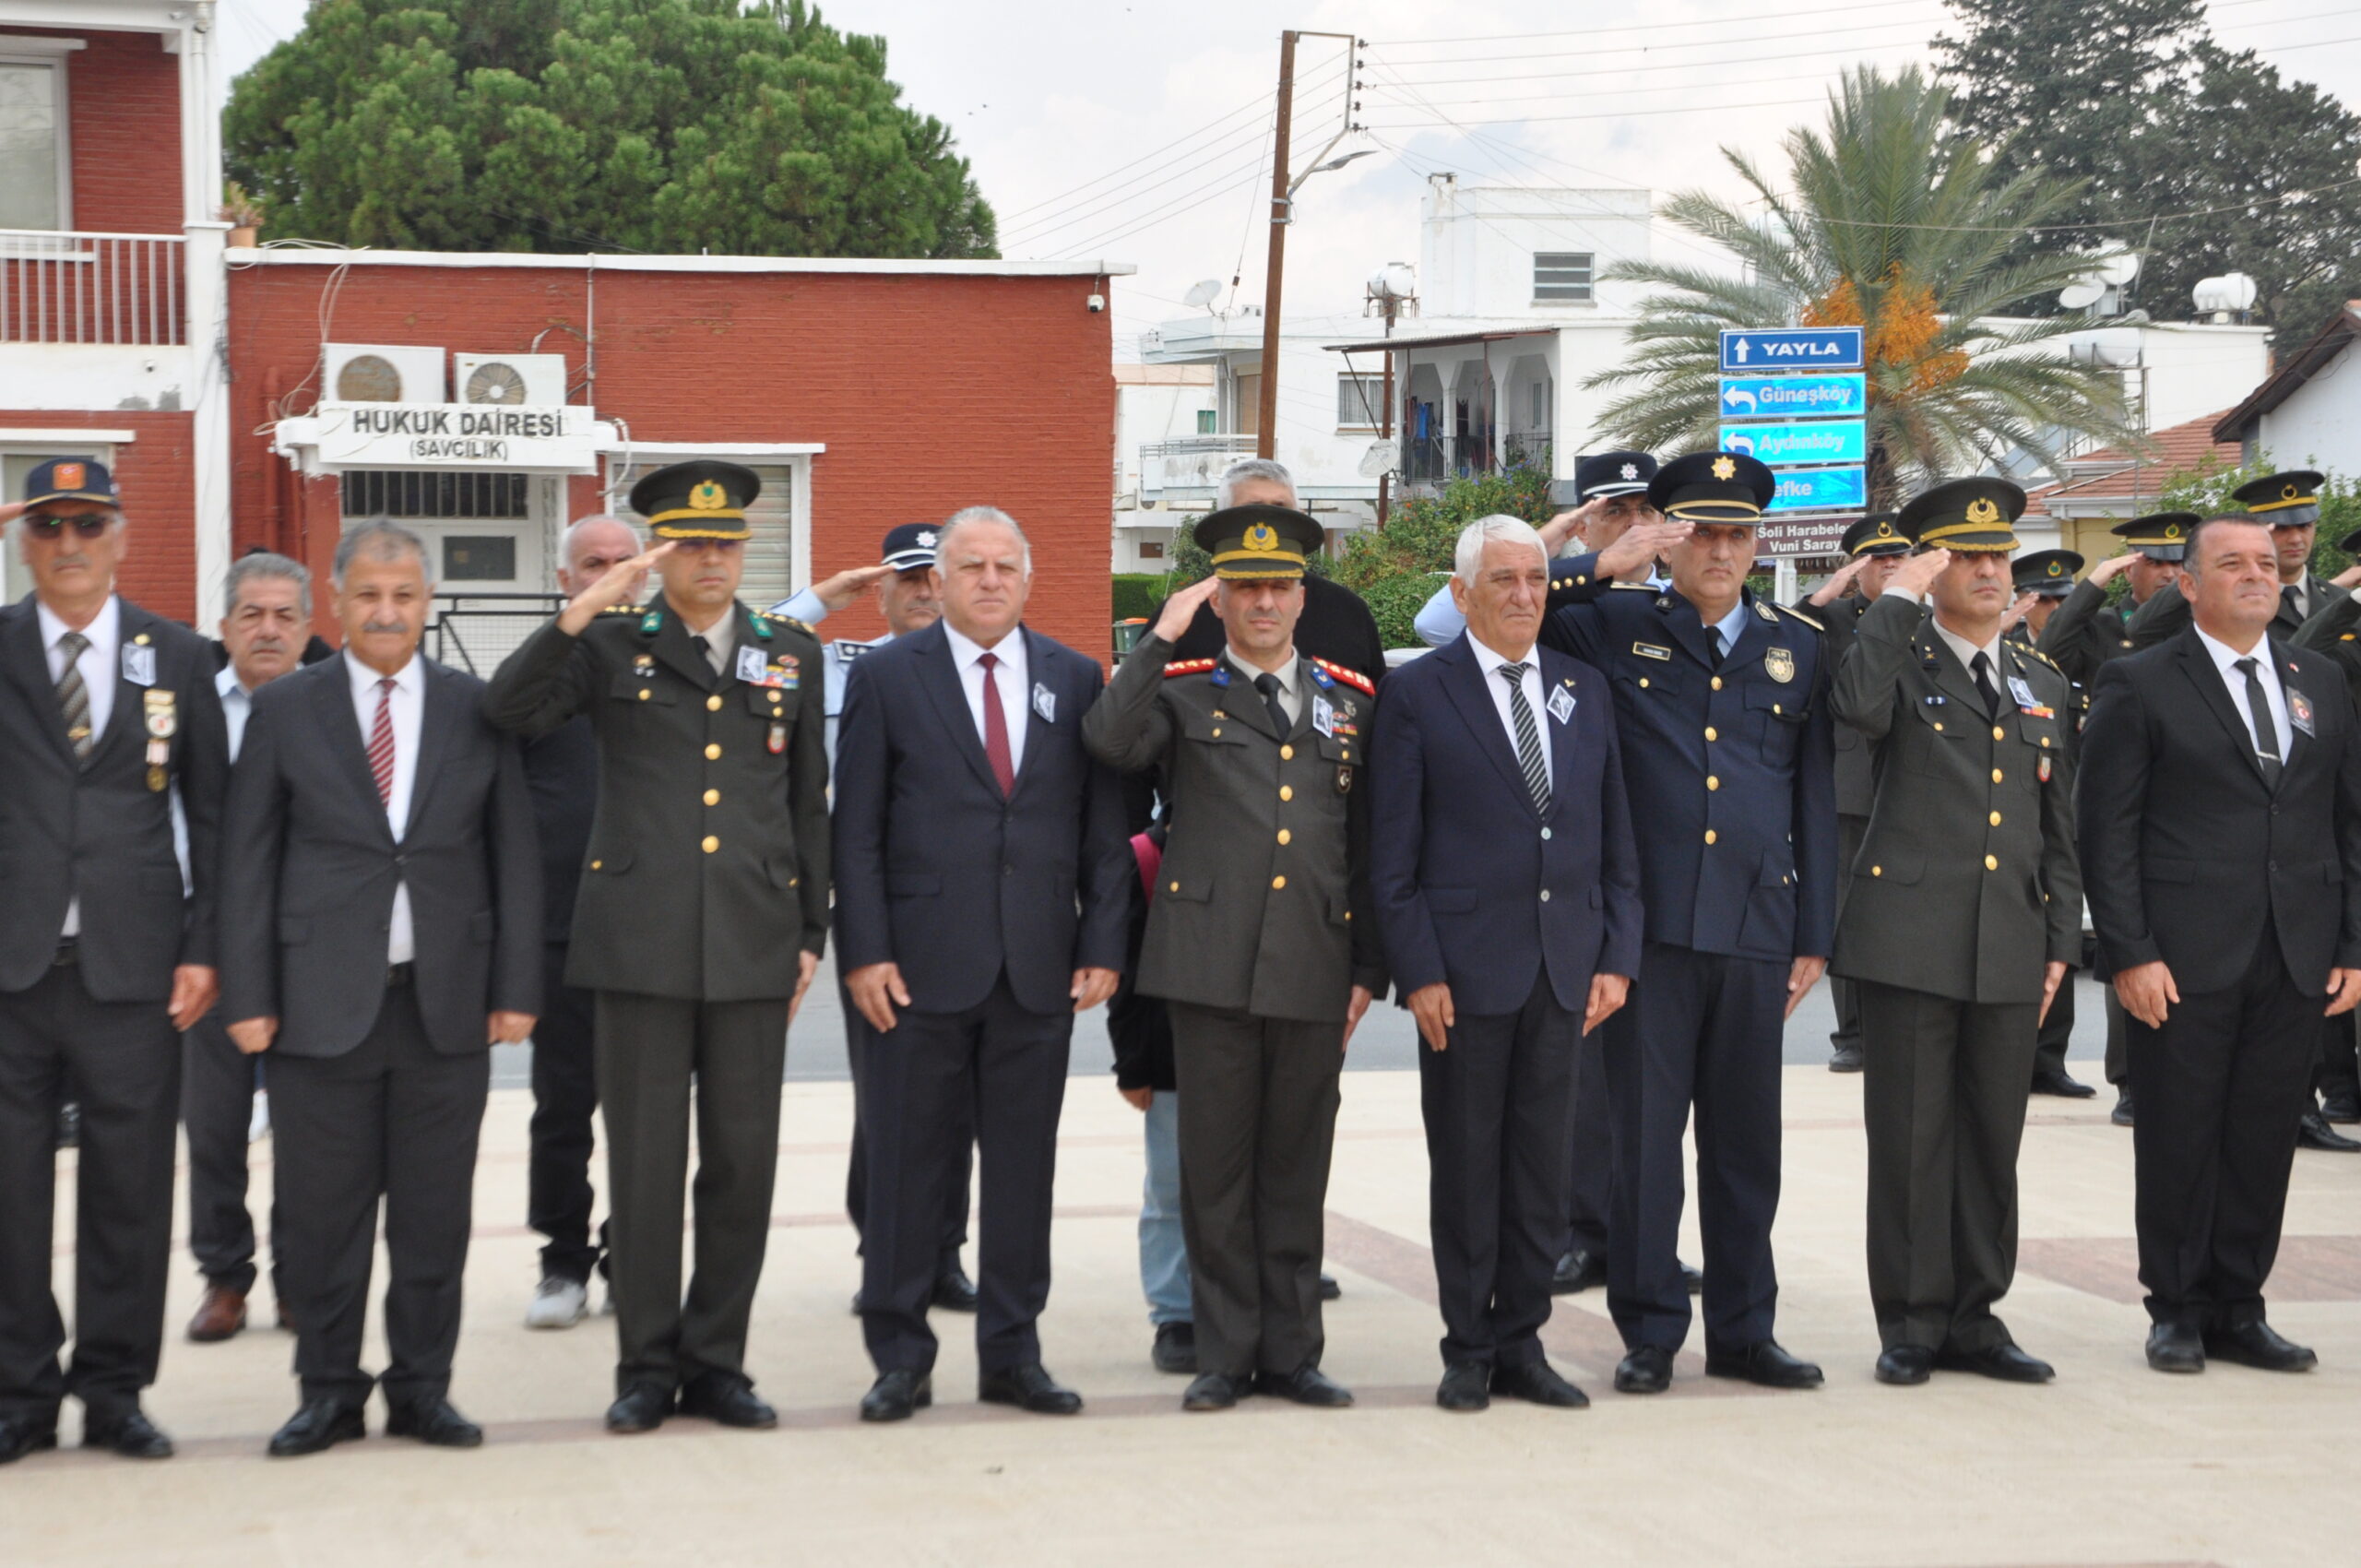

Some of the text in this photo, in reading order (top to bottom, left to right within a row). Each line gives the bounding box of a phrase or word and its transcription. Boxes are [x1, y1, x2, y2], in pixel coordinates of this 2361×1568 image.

[1762, 342, 1840, 356] YAYLA
[1759, 386, 1852, 406] Güneşköy
[353, 408, 562, 436] HUKUK DAİRESİ
[409, 440, 508, 462] (SAVCILIK)
[1759, 433, 1845, 455] Aydınköy
[1774, 481, 1813, 497] efke
[1758, 526, 1783, 539] Soli
[1769, 540, 1799, 552] Vuni
